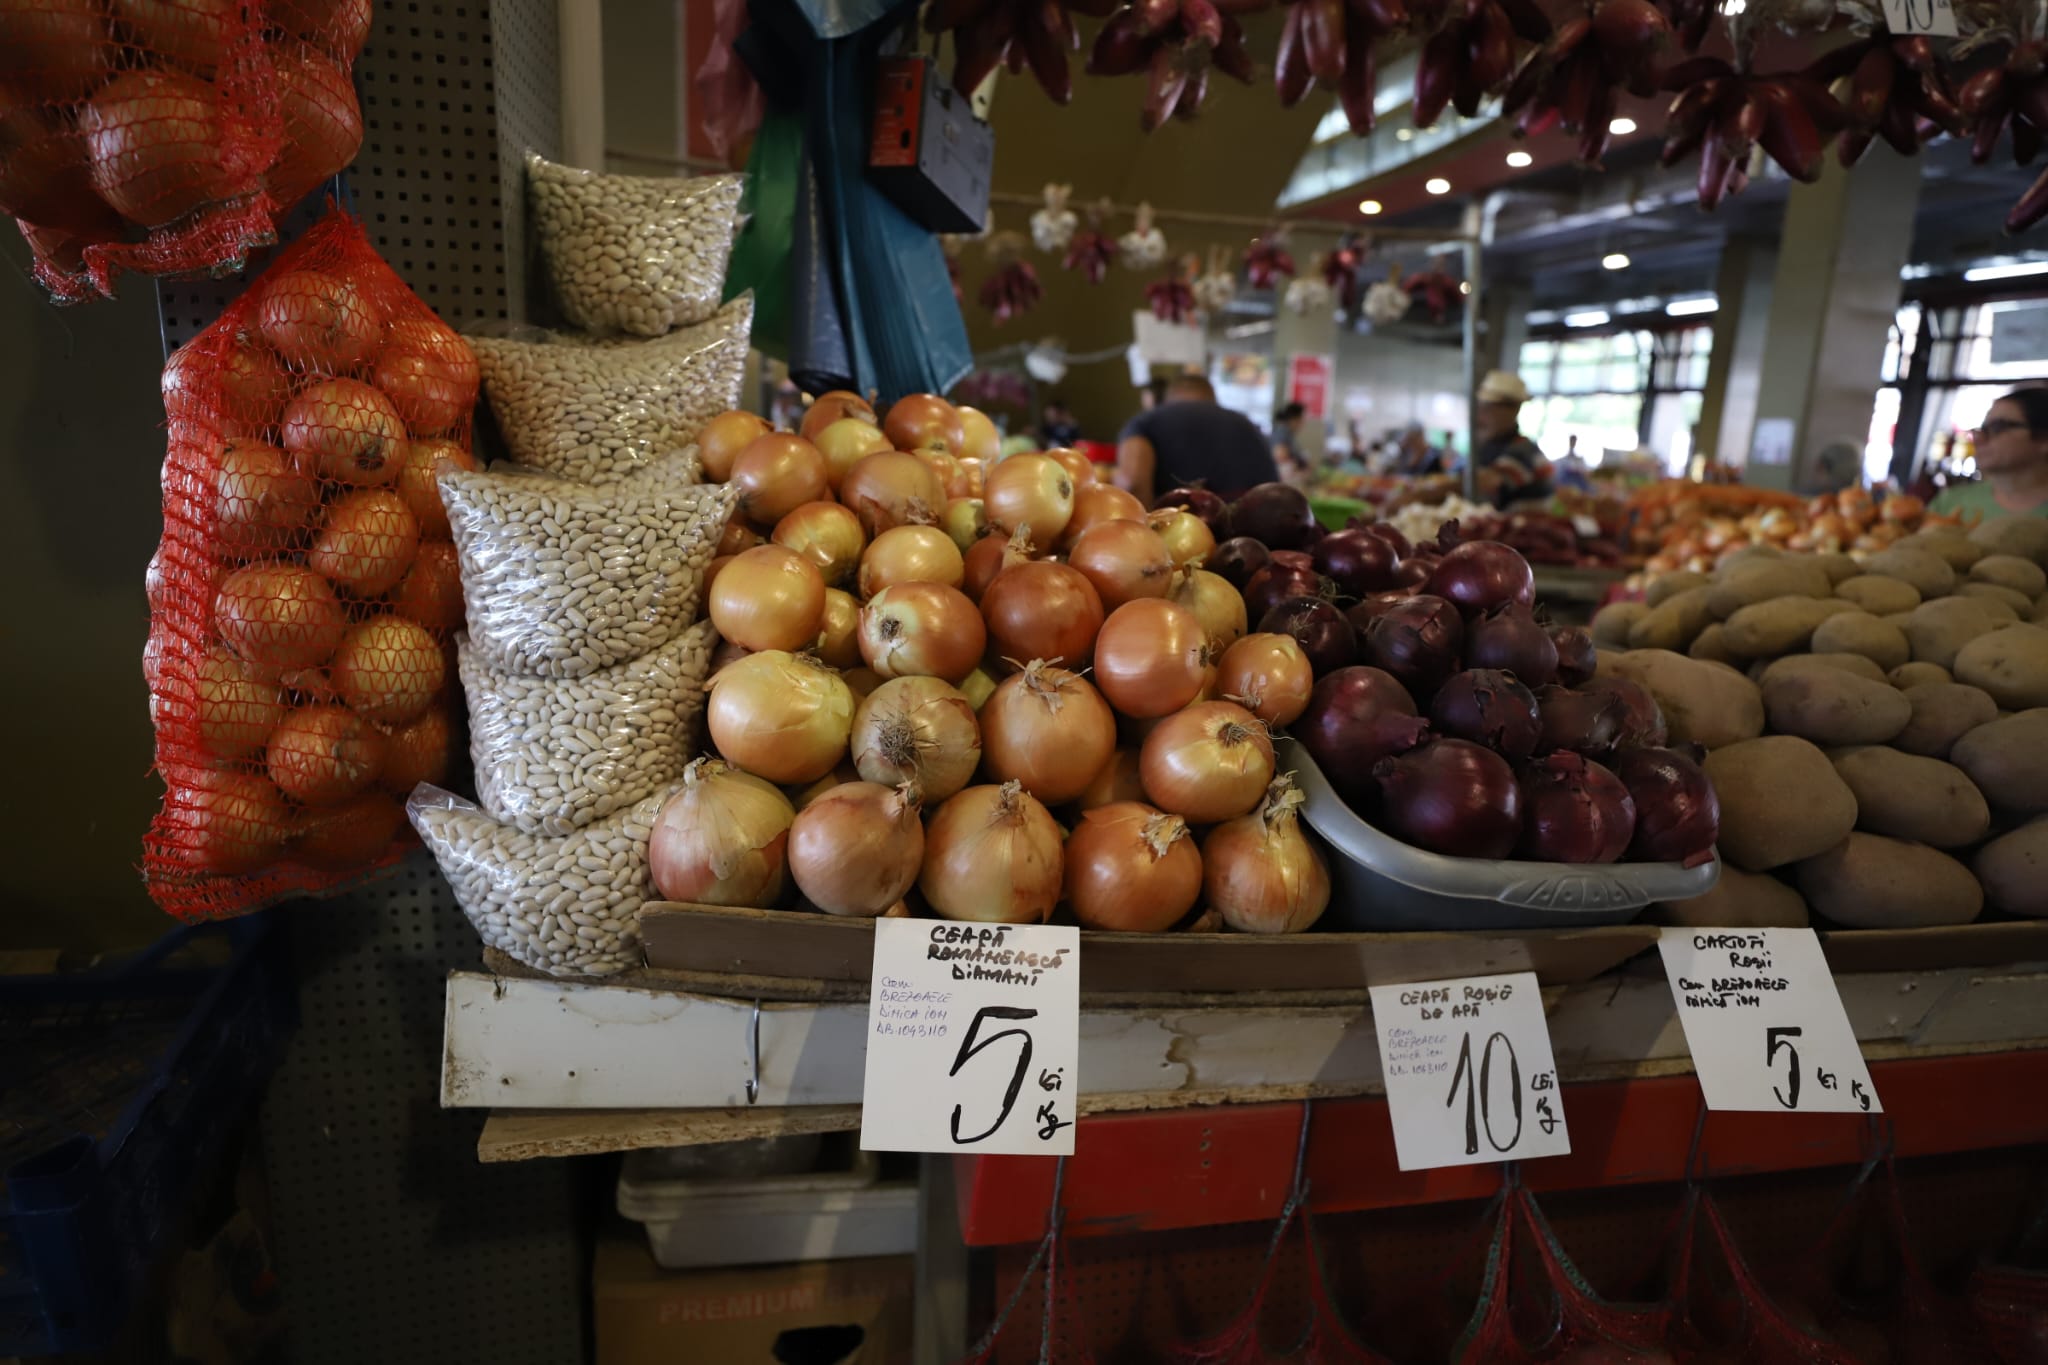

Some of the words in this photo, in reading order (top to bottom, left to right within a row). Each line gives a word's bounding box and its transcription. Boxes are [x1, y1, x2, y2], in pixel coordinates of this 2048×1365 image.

[949, 1006, 1038, 1144] 5
[1446, 1031, 1522, 1155] 10
[1766, 1027, 1802, 1109] 5
[659, 1287, 815, 1322] PREMIUM
